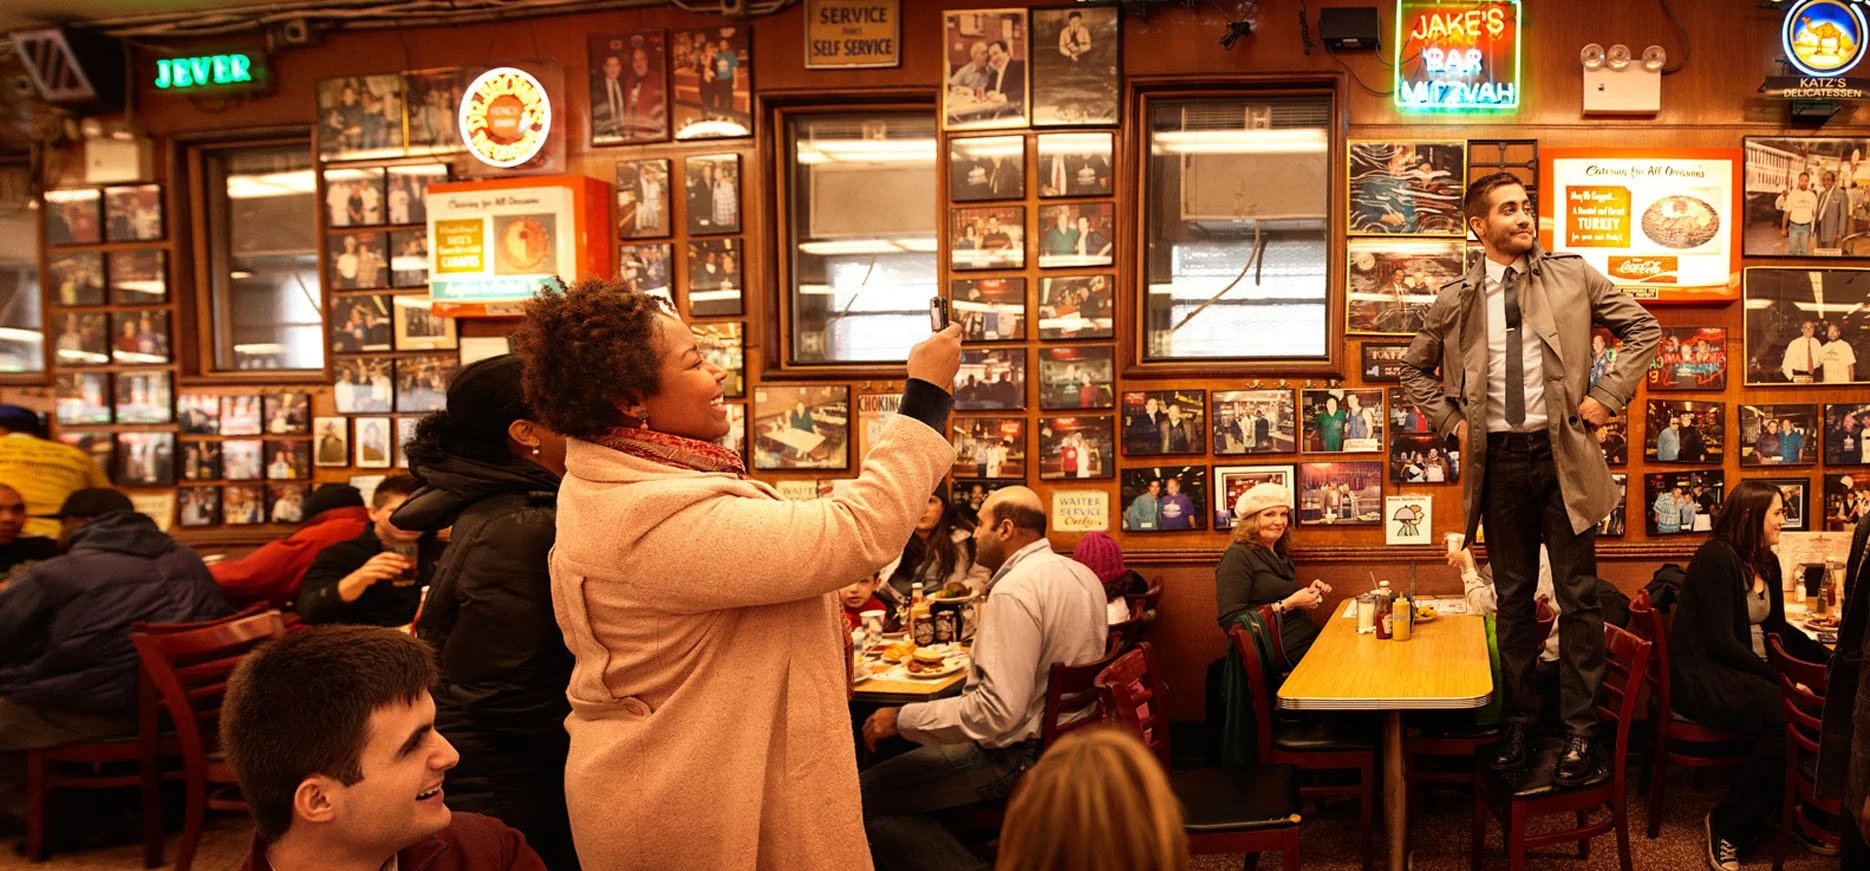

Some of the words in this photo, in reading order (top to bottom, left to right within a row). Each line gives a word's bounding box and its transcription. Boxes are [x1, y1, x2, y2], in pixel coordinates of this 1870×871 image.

[820, 6, 888, 24] SERVICE
[1411, 8, 1505, 39] JAKE'S
[813, 40, 841, 56] SELF
[845, 38, 893, 56] SERVICE
[1423, 47, 1482, 73] BAR
[154, 53, 252, 89] JEVER
[1800, 77, 1847, 88] KATZ'S
[1401, 80, 1514, 105] MITZVAH
[1783, 88, 1862, 98] DELICATESSEN
[1647, 165, 1662, 175] All
[1578, 217, 1620, 230] TURKEY
[1060, 497, 1101, 506] WAITER
[1060, 507, 1100, 517] SERVICE
